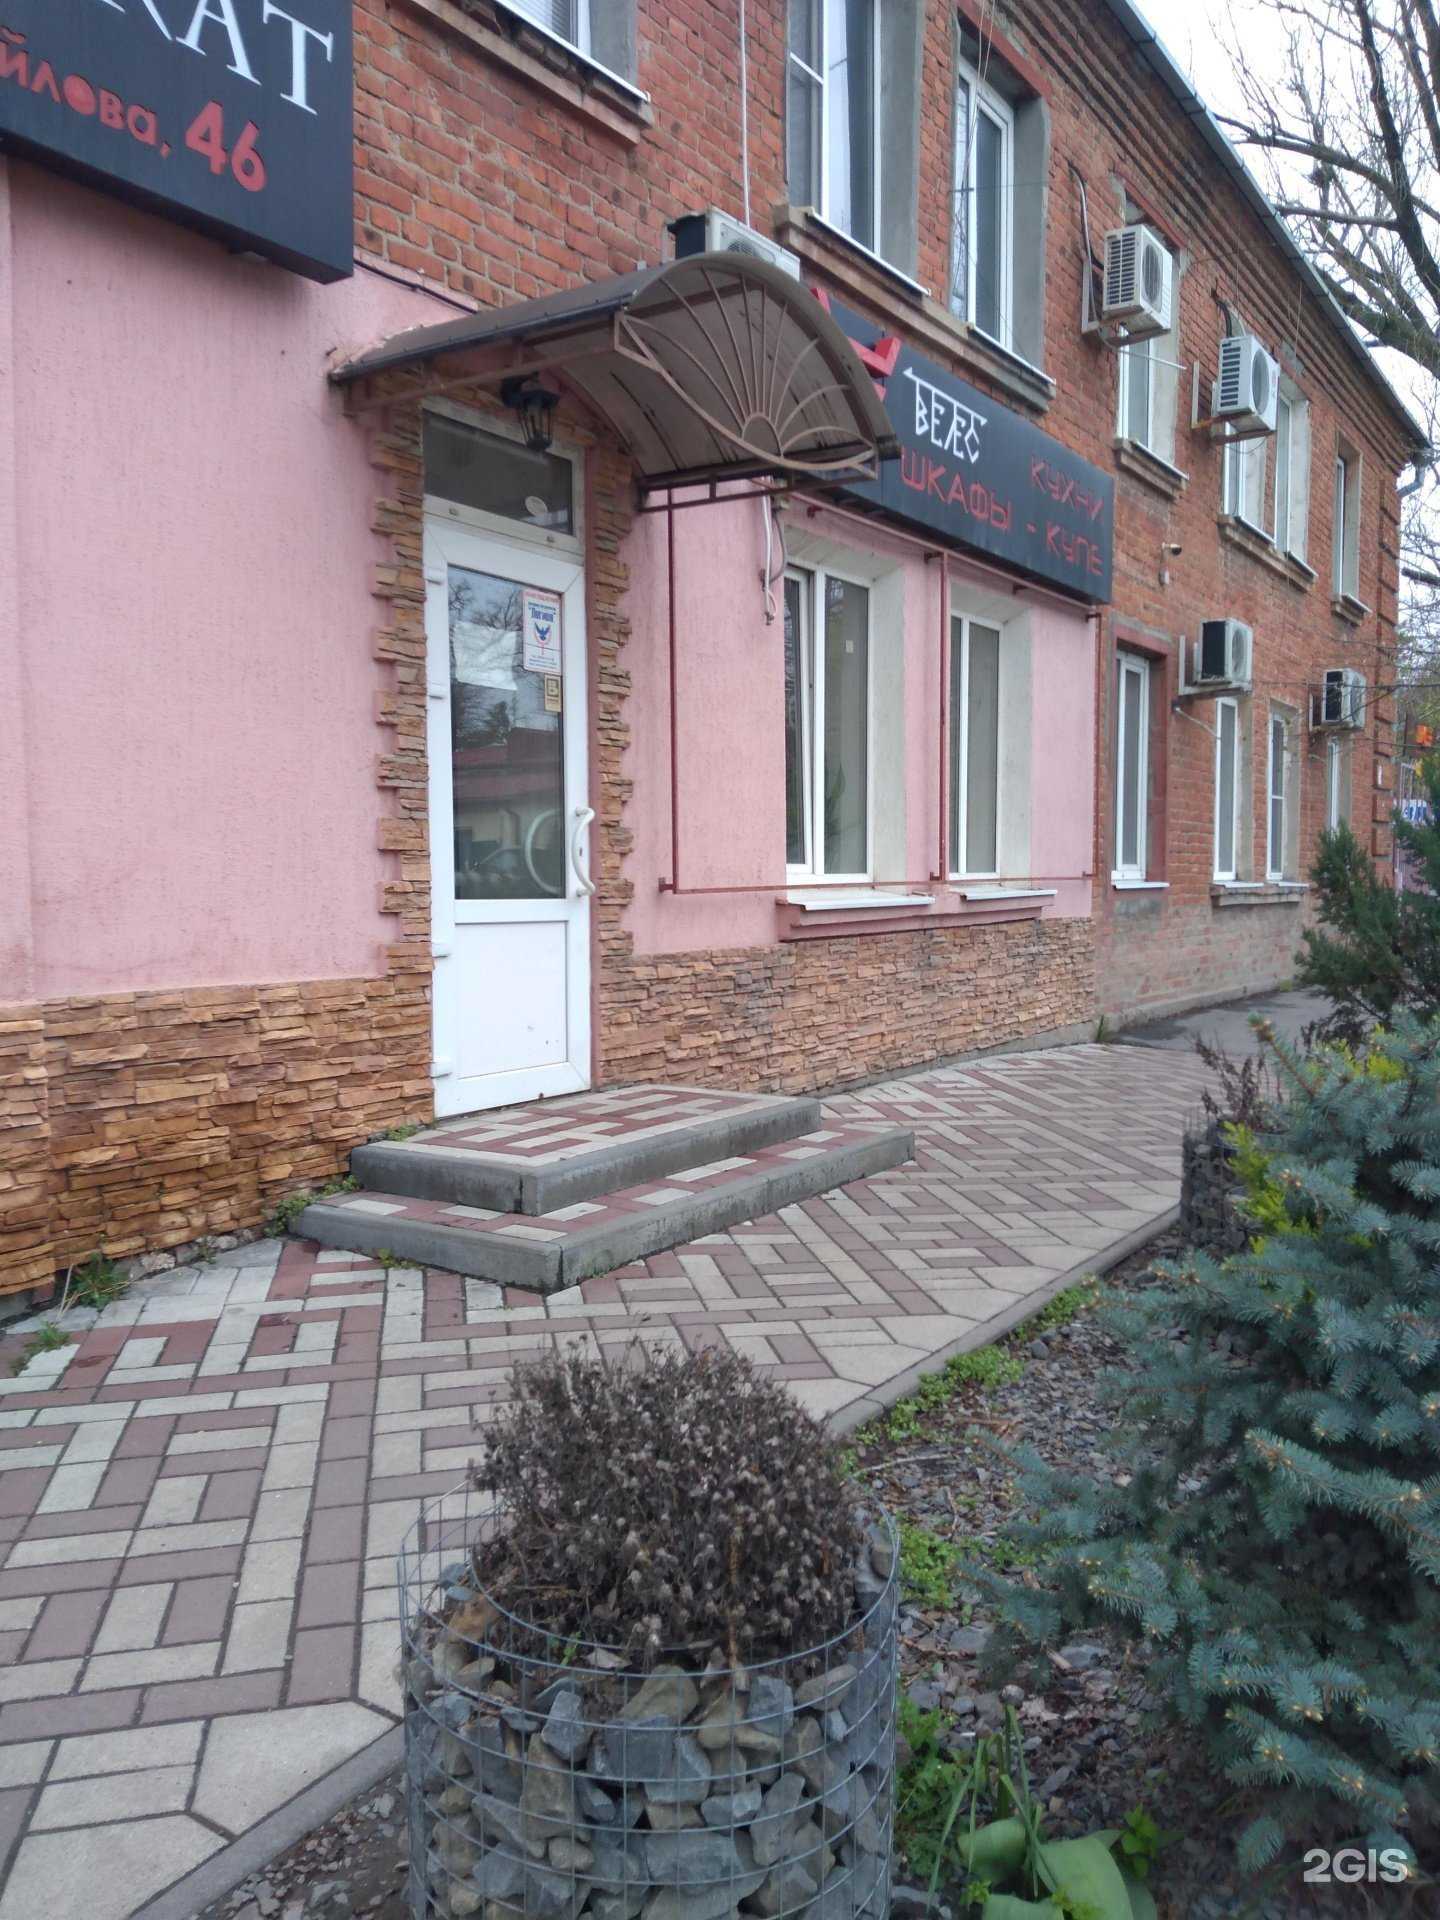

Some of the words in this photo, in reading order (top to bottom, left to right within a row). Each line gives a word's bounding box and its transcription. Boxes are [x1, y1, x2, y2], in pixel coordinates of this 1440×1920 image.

[185, 100, 267, 192] 46
[901, 446, 1013, 533] ШКАФЫ
[1045, 521, 1104, 576] КУПЕ
